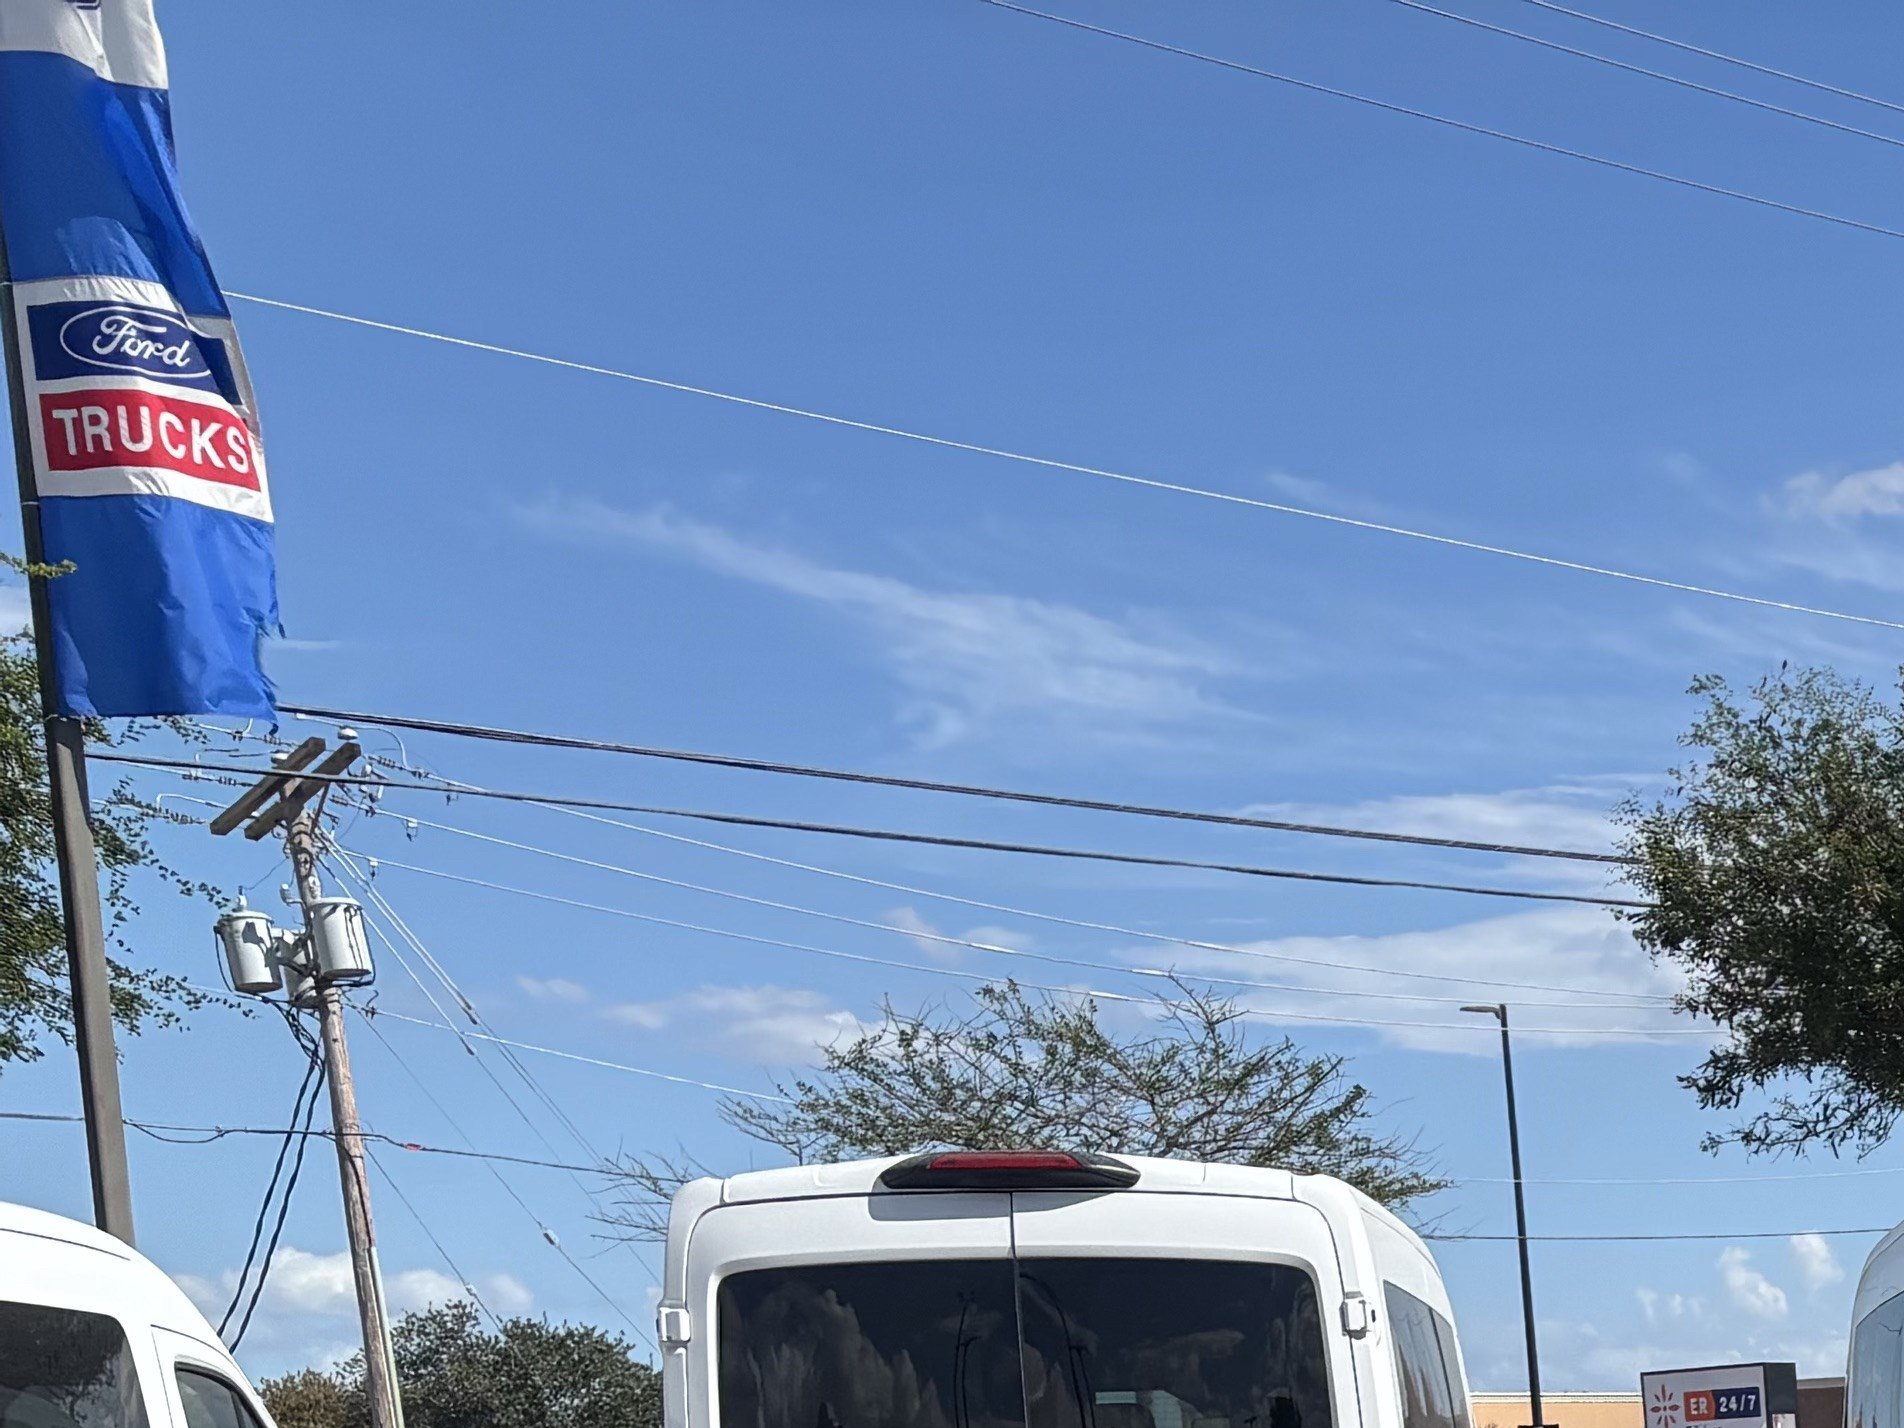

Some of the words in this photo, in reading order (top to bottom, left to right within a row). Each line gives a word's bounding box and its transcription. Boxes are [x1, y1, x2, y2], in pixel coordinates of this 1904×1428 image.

[92, 314, 192, 368] Ford
[52, 407, 251, 474] TRUCKS
[1689, 1396, 1709, 1415] ER
[1718, 1394, 1757, 1413] 24/7
